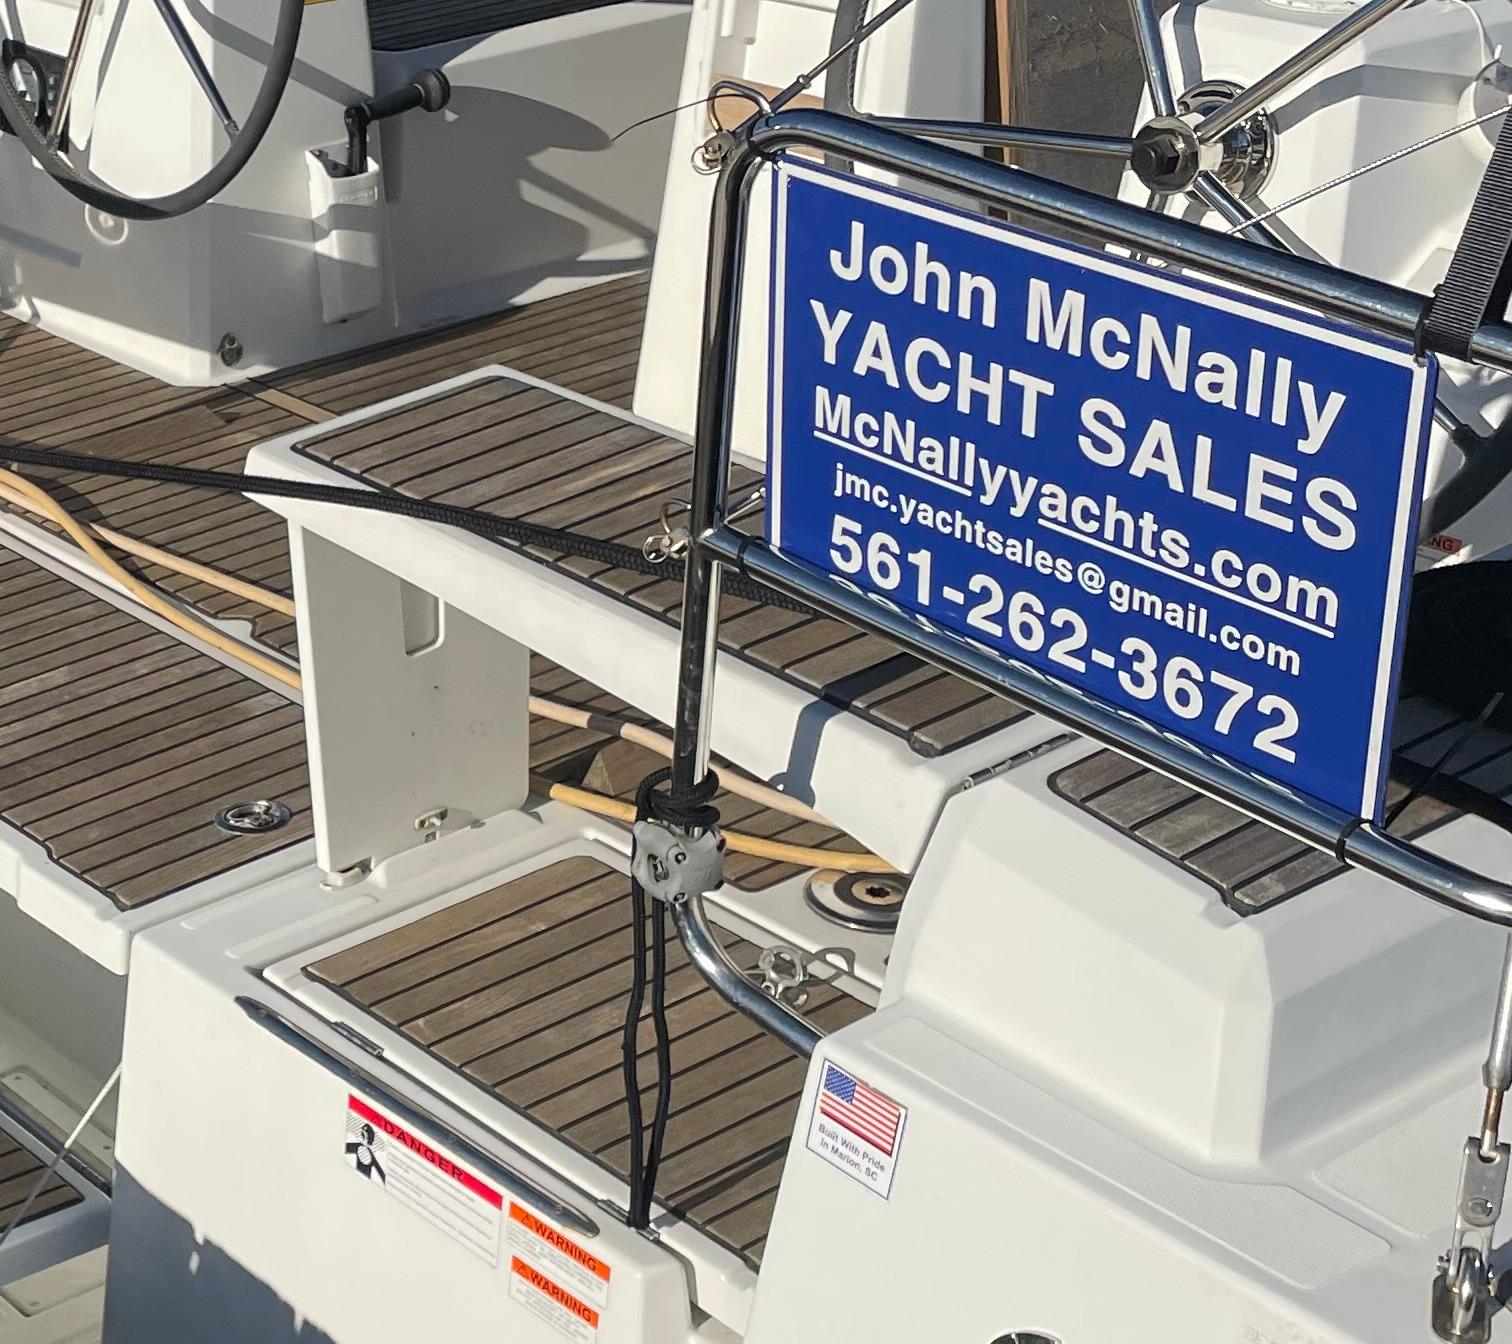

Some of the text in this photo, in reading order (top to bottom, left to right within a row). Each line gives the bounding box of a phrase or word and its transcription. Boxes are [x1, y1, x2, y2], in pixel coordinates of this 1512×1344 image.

[809, 298, 1358, 551] YACHT SALES
[829, 220, 1346, 455] John McNally
[814, 385, 1339, 634] McNallyyachts.com
[833, 462, 1301, 676] jmc.yachtsales@gmail.com
[829, 514, 1300, 764] 561-262-3672
[384, 1121, 464, 1180] DANGER
[536, 1222, 597, 1272] WARNING
[862, 1151, 885, 1172] Pride
[530, 1270, 592, 1322] WARNING
